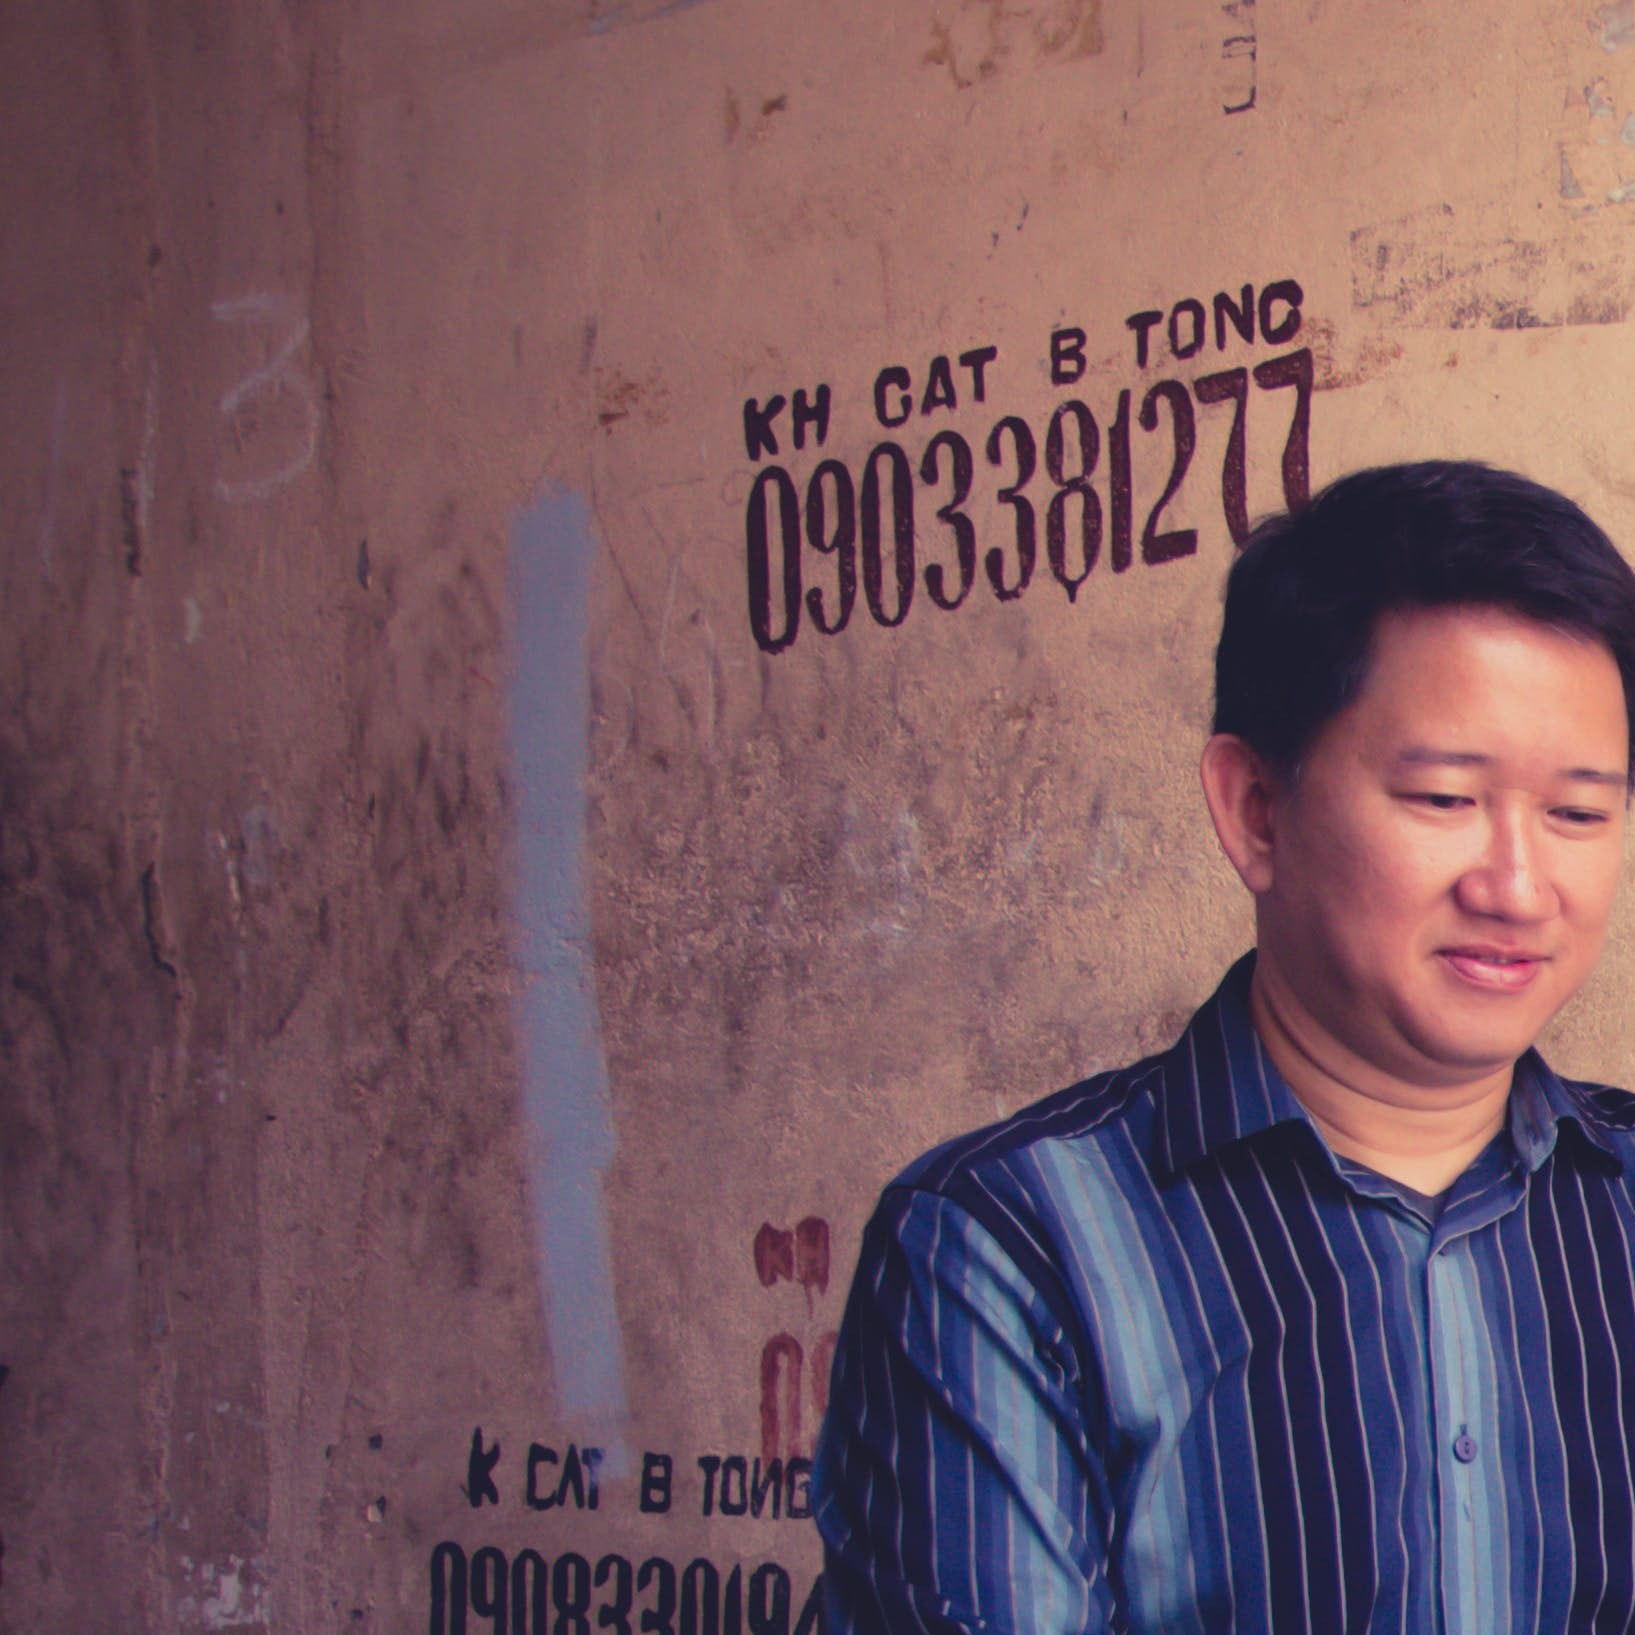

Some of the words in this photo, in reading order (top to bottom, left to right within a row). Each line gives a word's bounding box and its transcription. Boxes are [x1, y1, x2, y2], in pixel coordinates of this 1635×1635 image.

[743, 383, 831, 461] KH
[1050, 327, 1087, 386] B
[745, 347, 1313, 655] 0903381277
[526, 1442, 604, 1511] CAT
[640, 1452, 672, 1513] B
